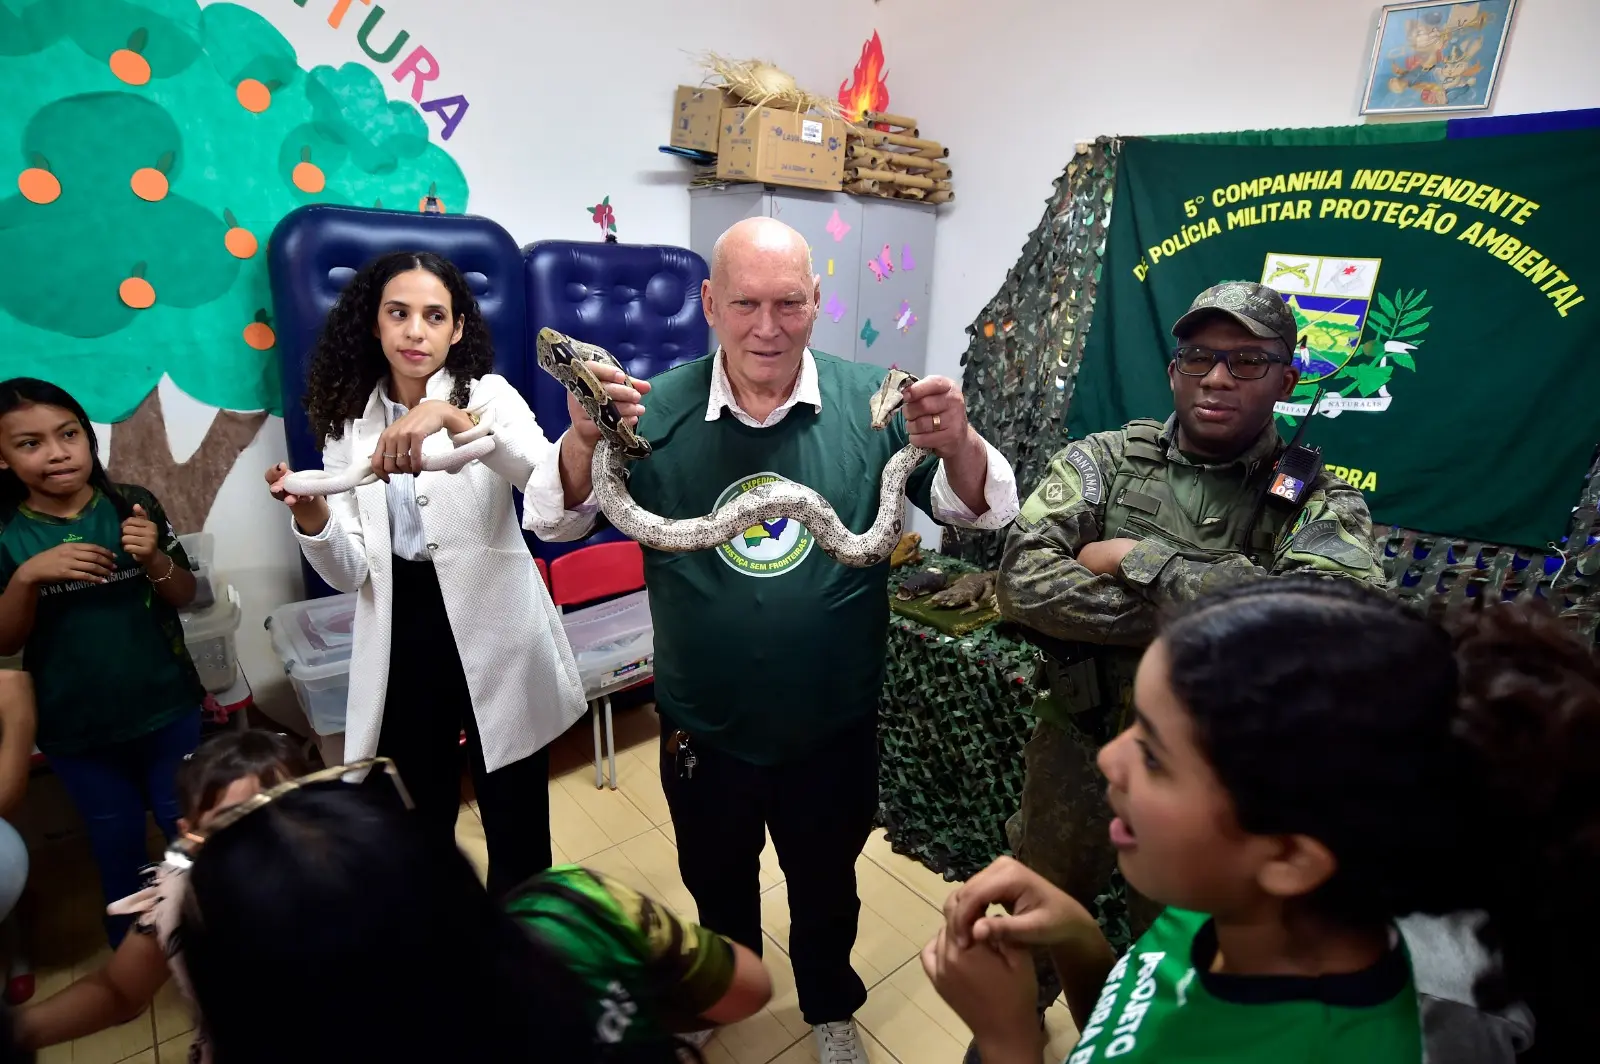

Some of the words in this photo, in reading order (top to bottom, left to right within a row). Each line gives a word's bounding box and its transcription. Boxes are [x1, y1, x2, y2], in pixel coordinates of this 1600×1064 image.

[293, 0, 469, 141] TURA
[1212, 169, 1343, 207] COMPANHIA
[1350, 169, 1540, 226] INDEPENDENTE
[1148, 217, 1222, 264] POLÍCIA
[1227, 199, 1312, 230] MILITAR
[1319, 198, 1458, 235] PROTEÇÃO
[1458, 221, 1586, 318] AMBIENTAL
[1069, 450, 1098, 497] PANTANAL
[1276, 485, 1295, 499] 06
[722, 542, 748, 568] JUSTIÇA
[769, 537, 808, 570] FRONTEIRAS
[1296, 522, 1335, 549] AMBIENTAL
[50, 585, 63, 594] NA
[66, 579, 96, 592] MINHA
[1104, 951, 1167, 1058] PROJETO
